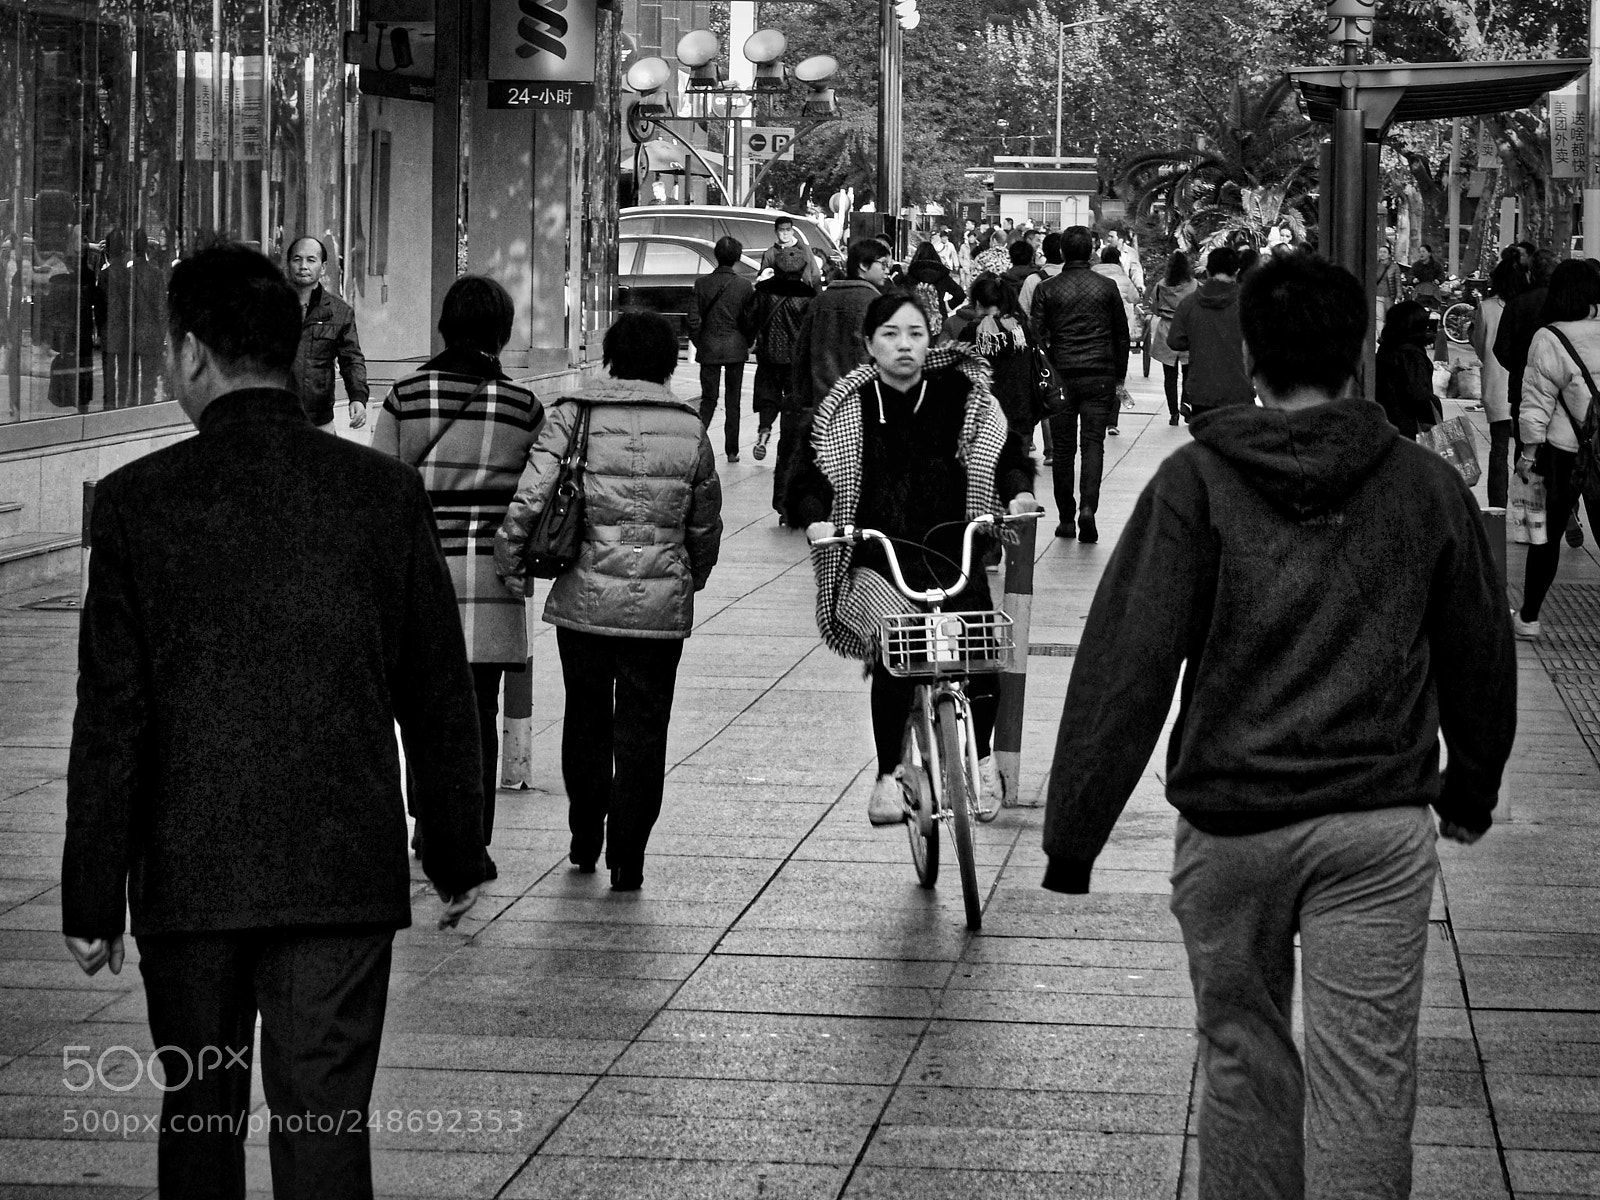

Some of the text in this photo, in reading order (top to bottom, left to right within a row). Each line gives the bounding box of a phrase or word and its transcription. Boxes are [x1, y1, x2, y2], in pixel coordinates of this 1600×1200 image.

[508, 88, 573, 105] 24-小时
[776, 136, 787, 151] P
[1554, 101, 1569, 164] 美团外卖
[1571, 111, 1586, 173] 送啥都快
